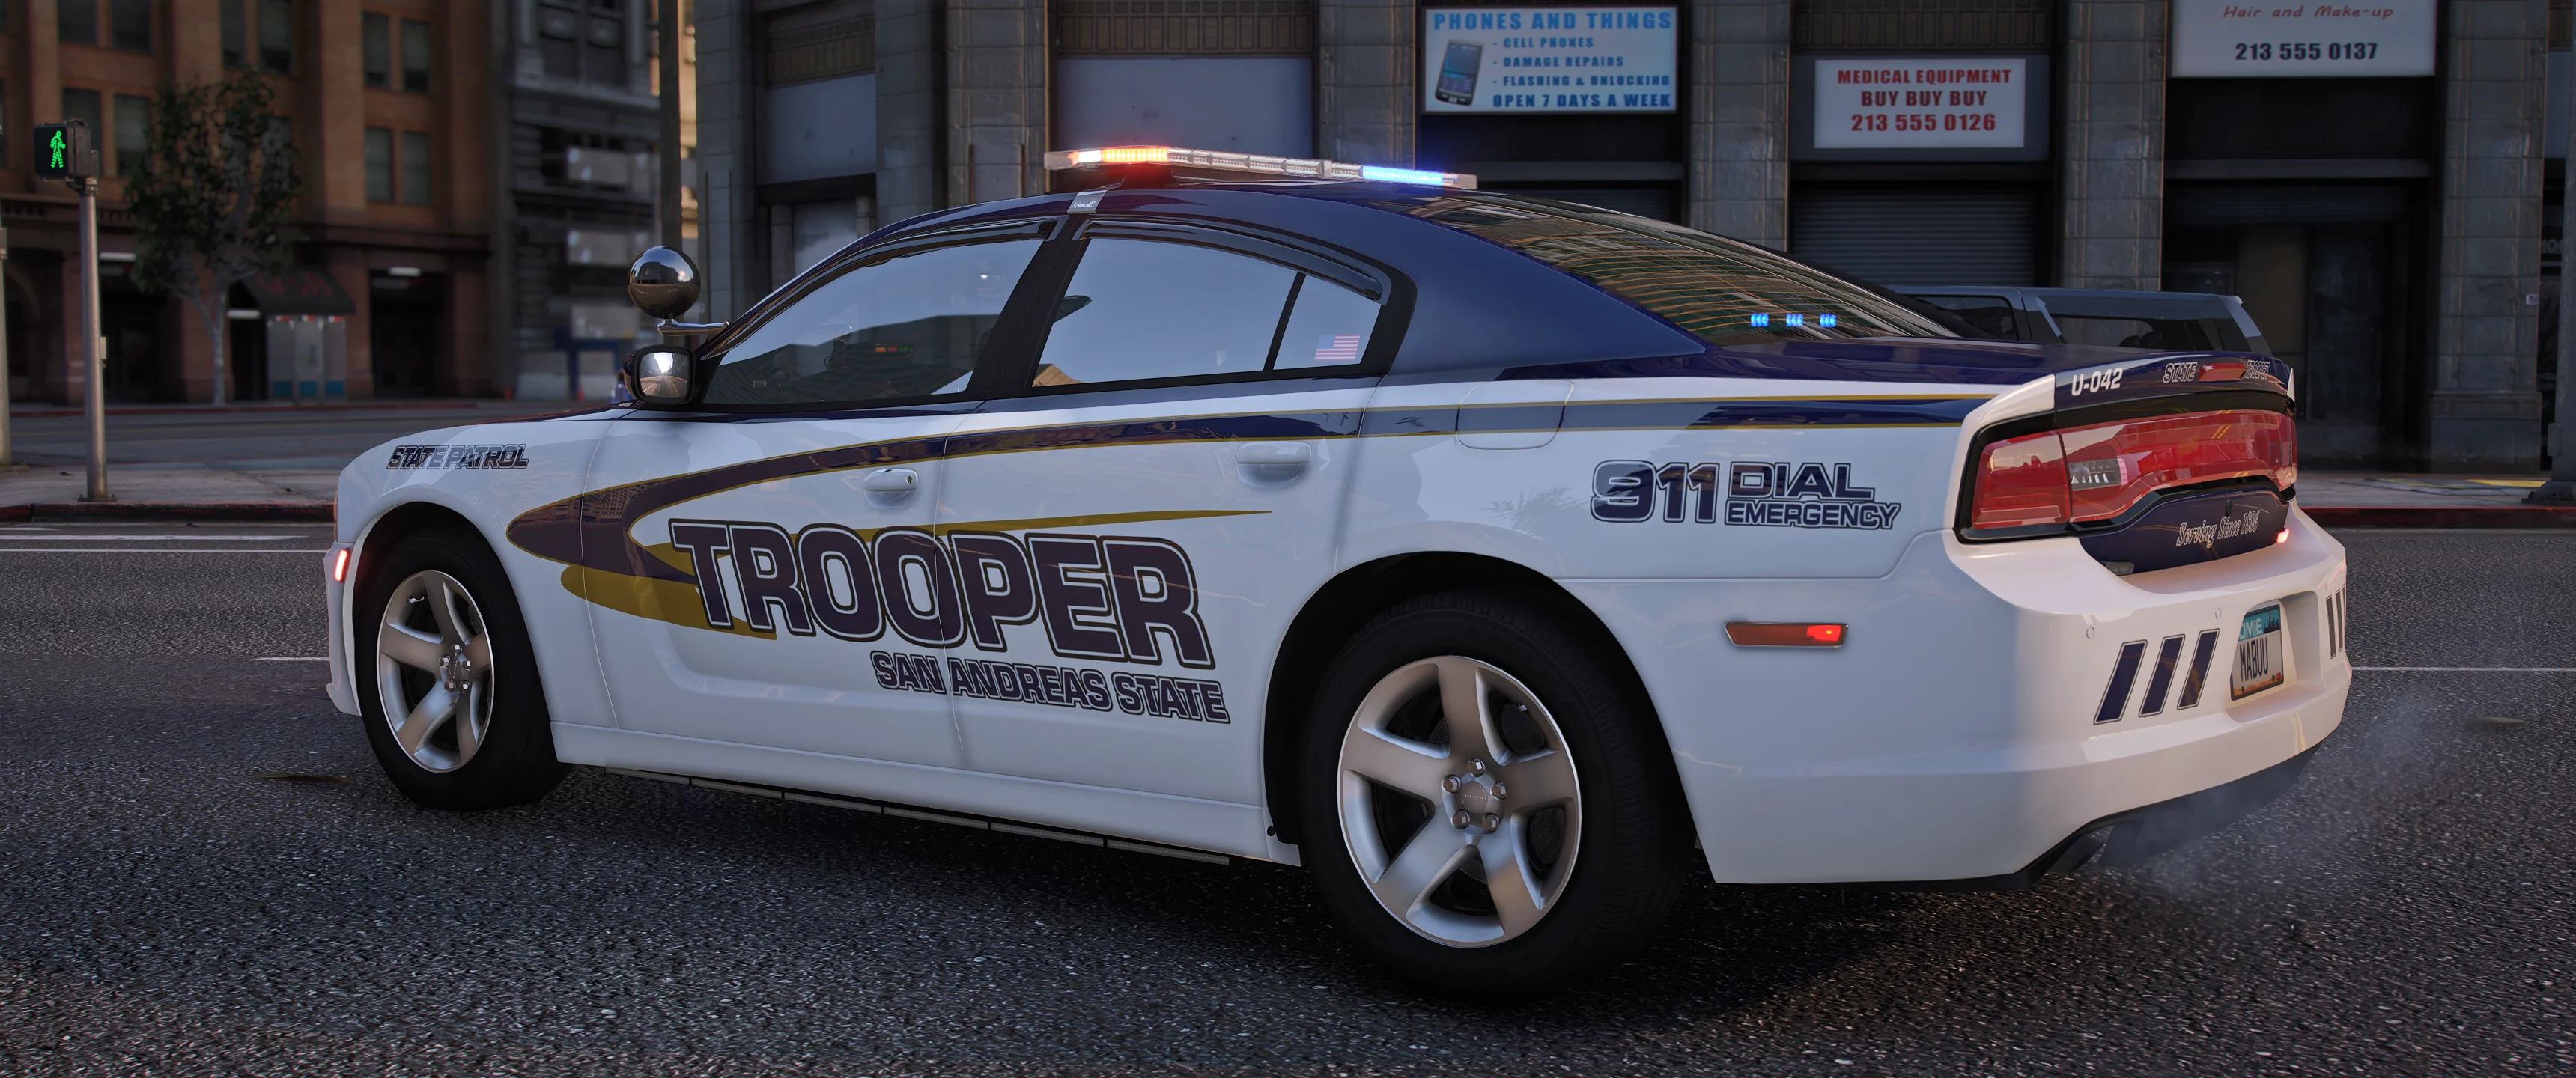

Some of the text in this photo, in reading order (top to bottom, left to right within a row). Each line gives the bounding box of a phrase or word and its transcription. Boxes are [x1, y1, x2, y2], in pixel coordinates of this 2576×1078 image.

[1433, 11, 1672, 31] PHONES AND THINGS
[2223, 4, 2395, 20] Hair and Make-up
[1503, 37, 1534, 49] CELL
[1540, 37, 1594, 48] PHONES
[2235, 42, 2378, 61] 213 555 0137
[1503, 56, 1560, 67] DAMAGE
[1565, 56, 1624, 67] REPAIRS
[1503, 75, 1570, 86] FLASHING
[1576, 76, 1585, 86] &
[1590, 75, 1670, 86] UNLOCKING
[1837, 69, 2012, 85] MEDICAL EQUIPMENT
[1492, 94, 1671, 108] OPEN 7 DAYS A WEEK
[1861, 90, 1987, 107] BUY BUY BUY
[1851, 113, 1996, 132] 213 555 0126
[2071, 367, 2124, 397] U-042
[2163, 362, 2198, 383] STATE
[386, 443, 529, 469] STATE PATROL
[1591, 459, 1875, 524] 911 DIAL
[1724, 499, 1901, 530] EMERGENCY
[2175, 519, 2218, 549] Serving
[2217, 516, 2241, 540] Since
[667, 517, 1216, 670] TROOPER
[2239, 636, 2269, 683] MABUU
[870, 650, 1231, 725] SAN ANDREAS STATE
